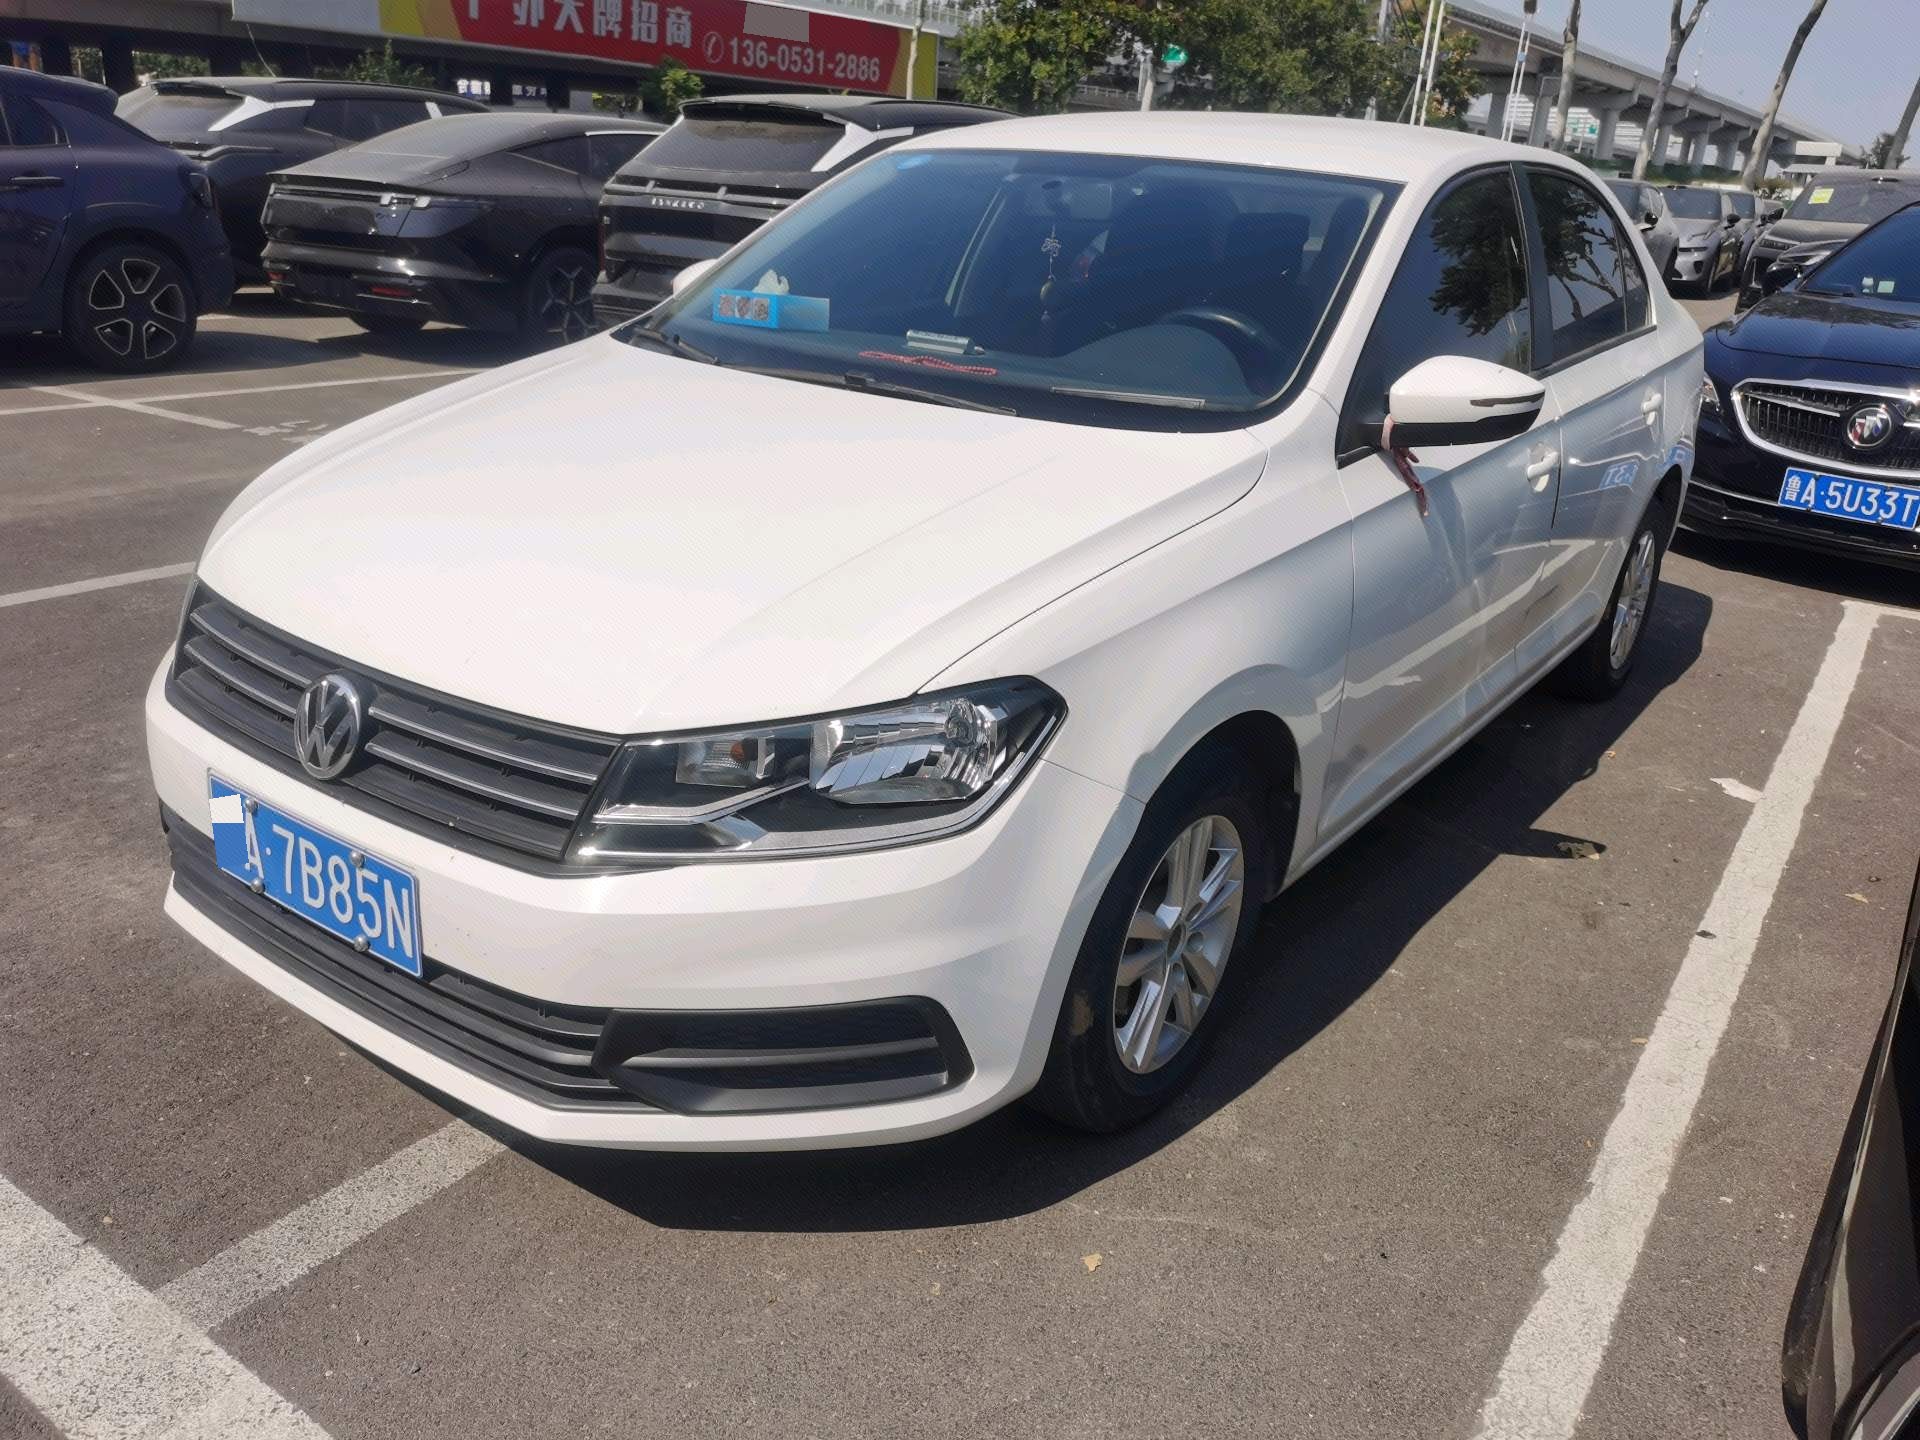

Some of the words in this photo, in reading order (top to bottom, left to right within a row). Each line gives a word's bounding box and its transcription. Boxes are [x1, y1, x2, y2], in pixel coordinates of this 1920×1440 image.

[466, 0, 692, 48] 外大牌招商
[729, 37, 880, 82] 136-0531-2886
[212, 795, 413, 959] A·7B85N
